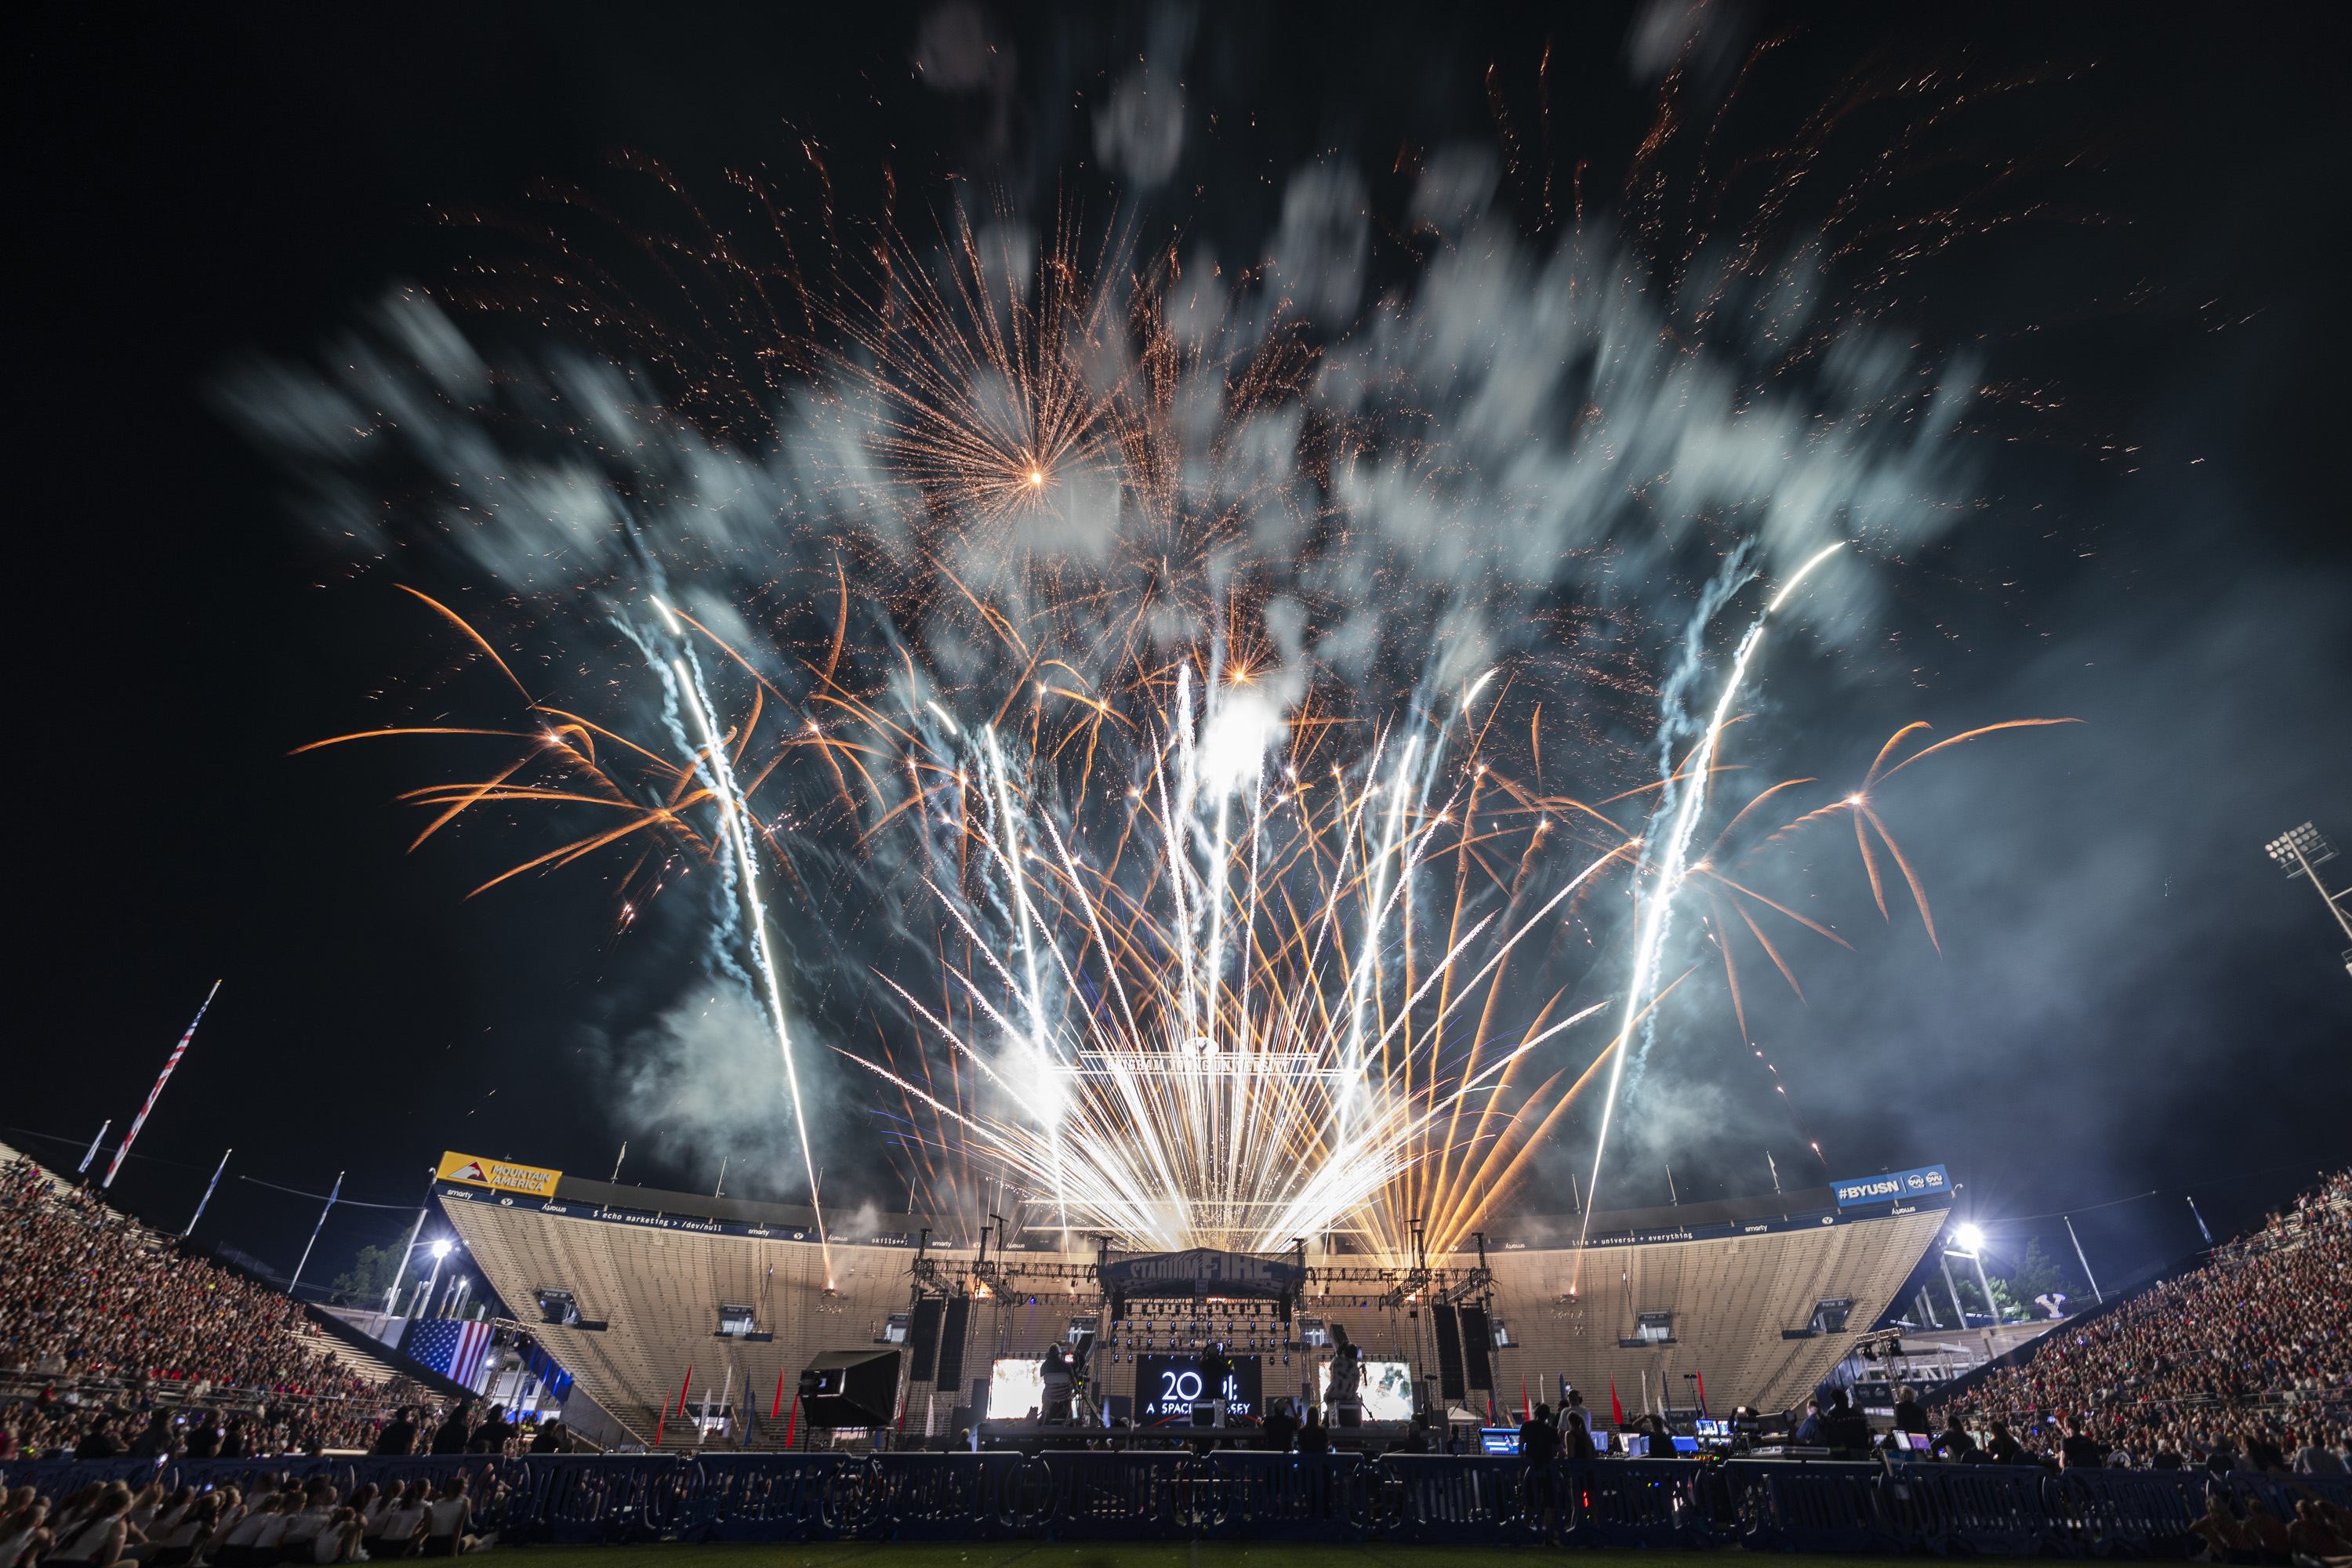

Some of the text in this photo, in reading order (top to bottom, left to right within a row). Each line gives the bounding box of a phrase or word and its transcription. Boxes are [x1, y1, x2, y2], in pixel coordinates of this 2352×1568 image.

[1106, 1059, 1163, 1072] BIGHAM
[1214, 1059, 1290, 1072] UNIERSITY
[492, 1165, 551, 1182] MOUNTAIN
[492, 1177, 543, 1191] AMERICA
[1838, 1181, 1900, 1200] #BYUSN
[446, 1189, 473, 1200] smarty
[602, 1211, 622, 1220] echo
[626, 1214, 669, 1227] marketing
[681, 1221, 722, 1232] /dev/null
[1745, 1224, 1767, 1232] smarty
[1601, 1236, 1635, 1245] universe
[1648, 1232, 1693, 1242] everything
[1202, 1251, 1272, 1279] FIRE
[1161, 1371, 1237, 1401] 201:
[1145, 1403, 1192, 1414] A SPAC
